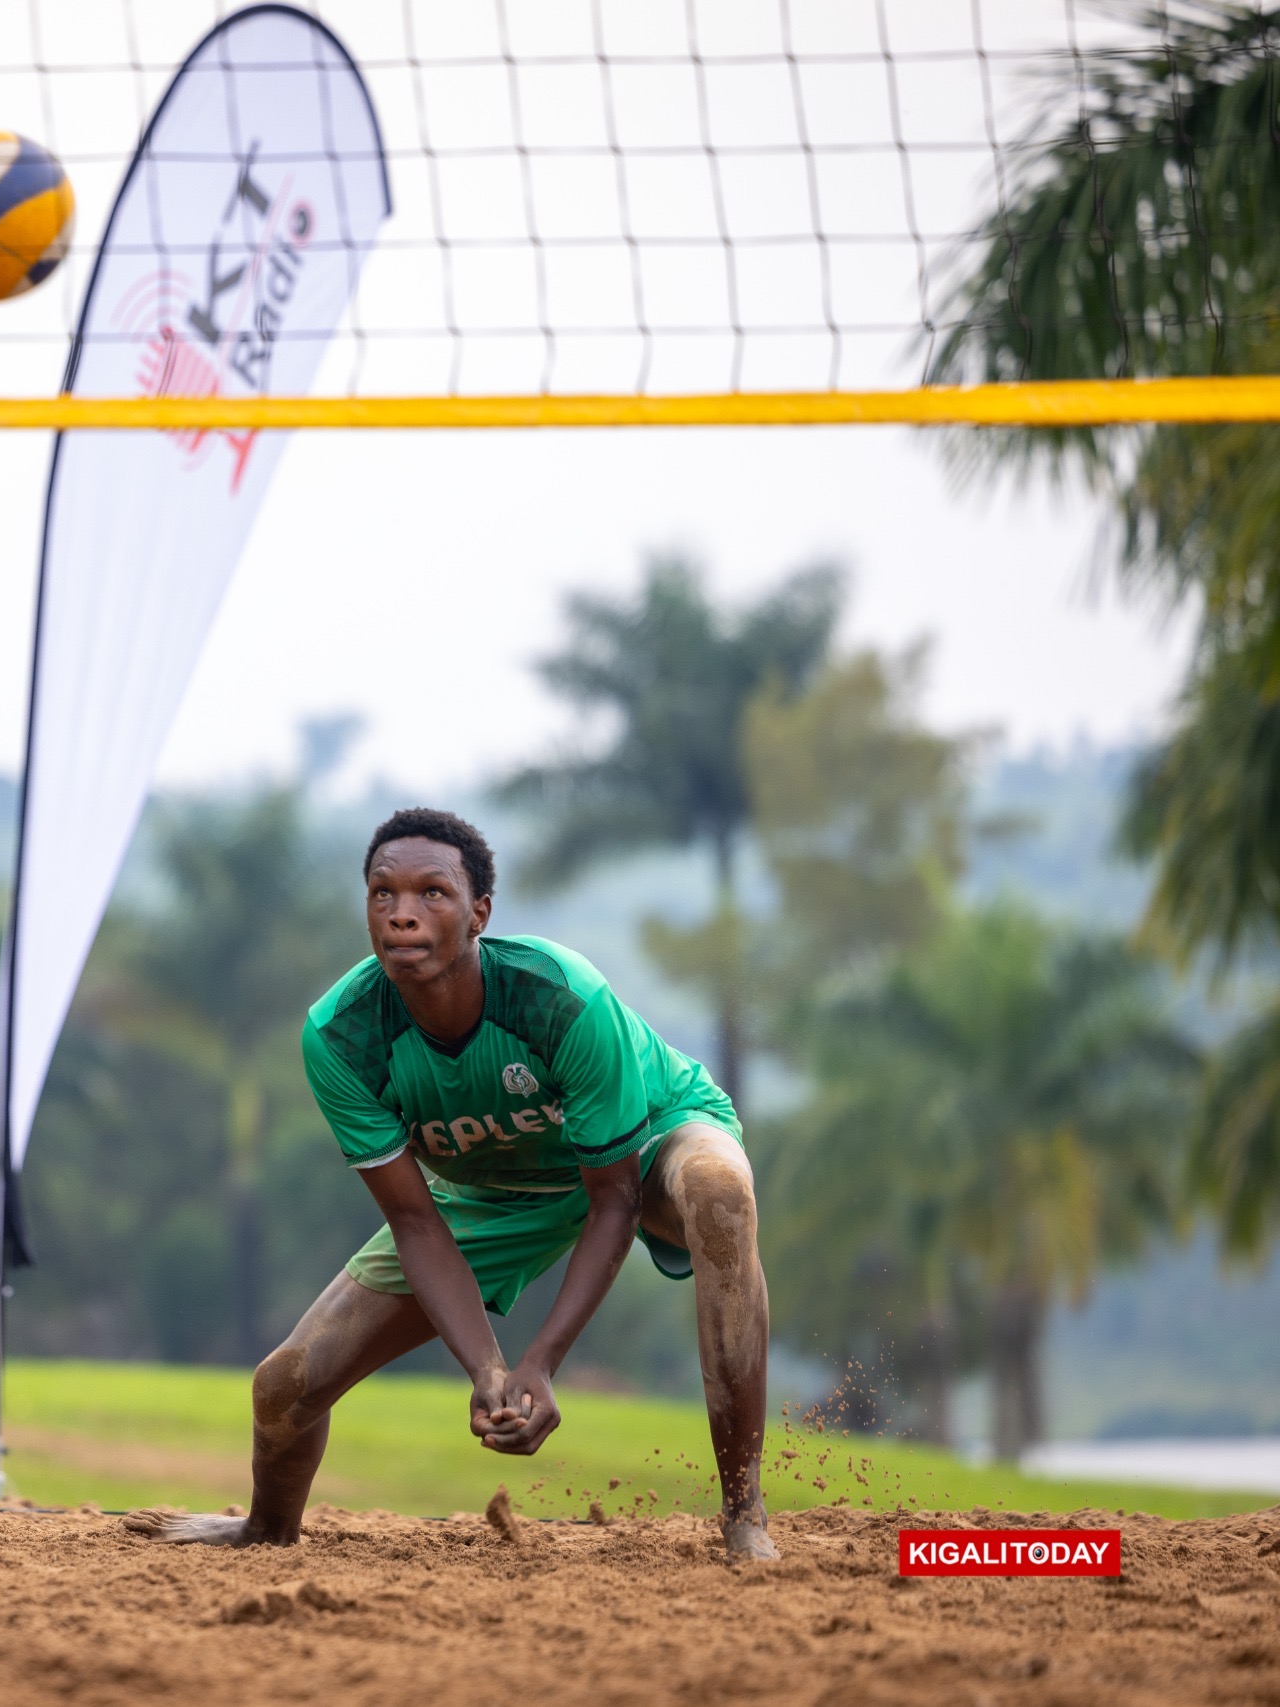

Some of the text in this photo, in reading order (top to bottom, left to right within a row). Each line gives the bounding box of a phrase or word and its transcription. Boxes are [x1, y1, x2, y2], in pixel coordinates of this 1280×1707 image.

[187, 138, 270, 345] KT
[229, 198, 315, 388] Radio
[409, 1099, 565, 1157] EPLE
